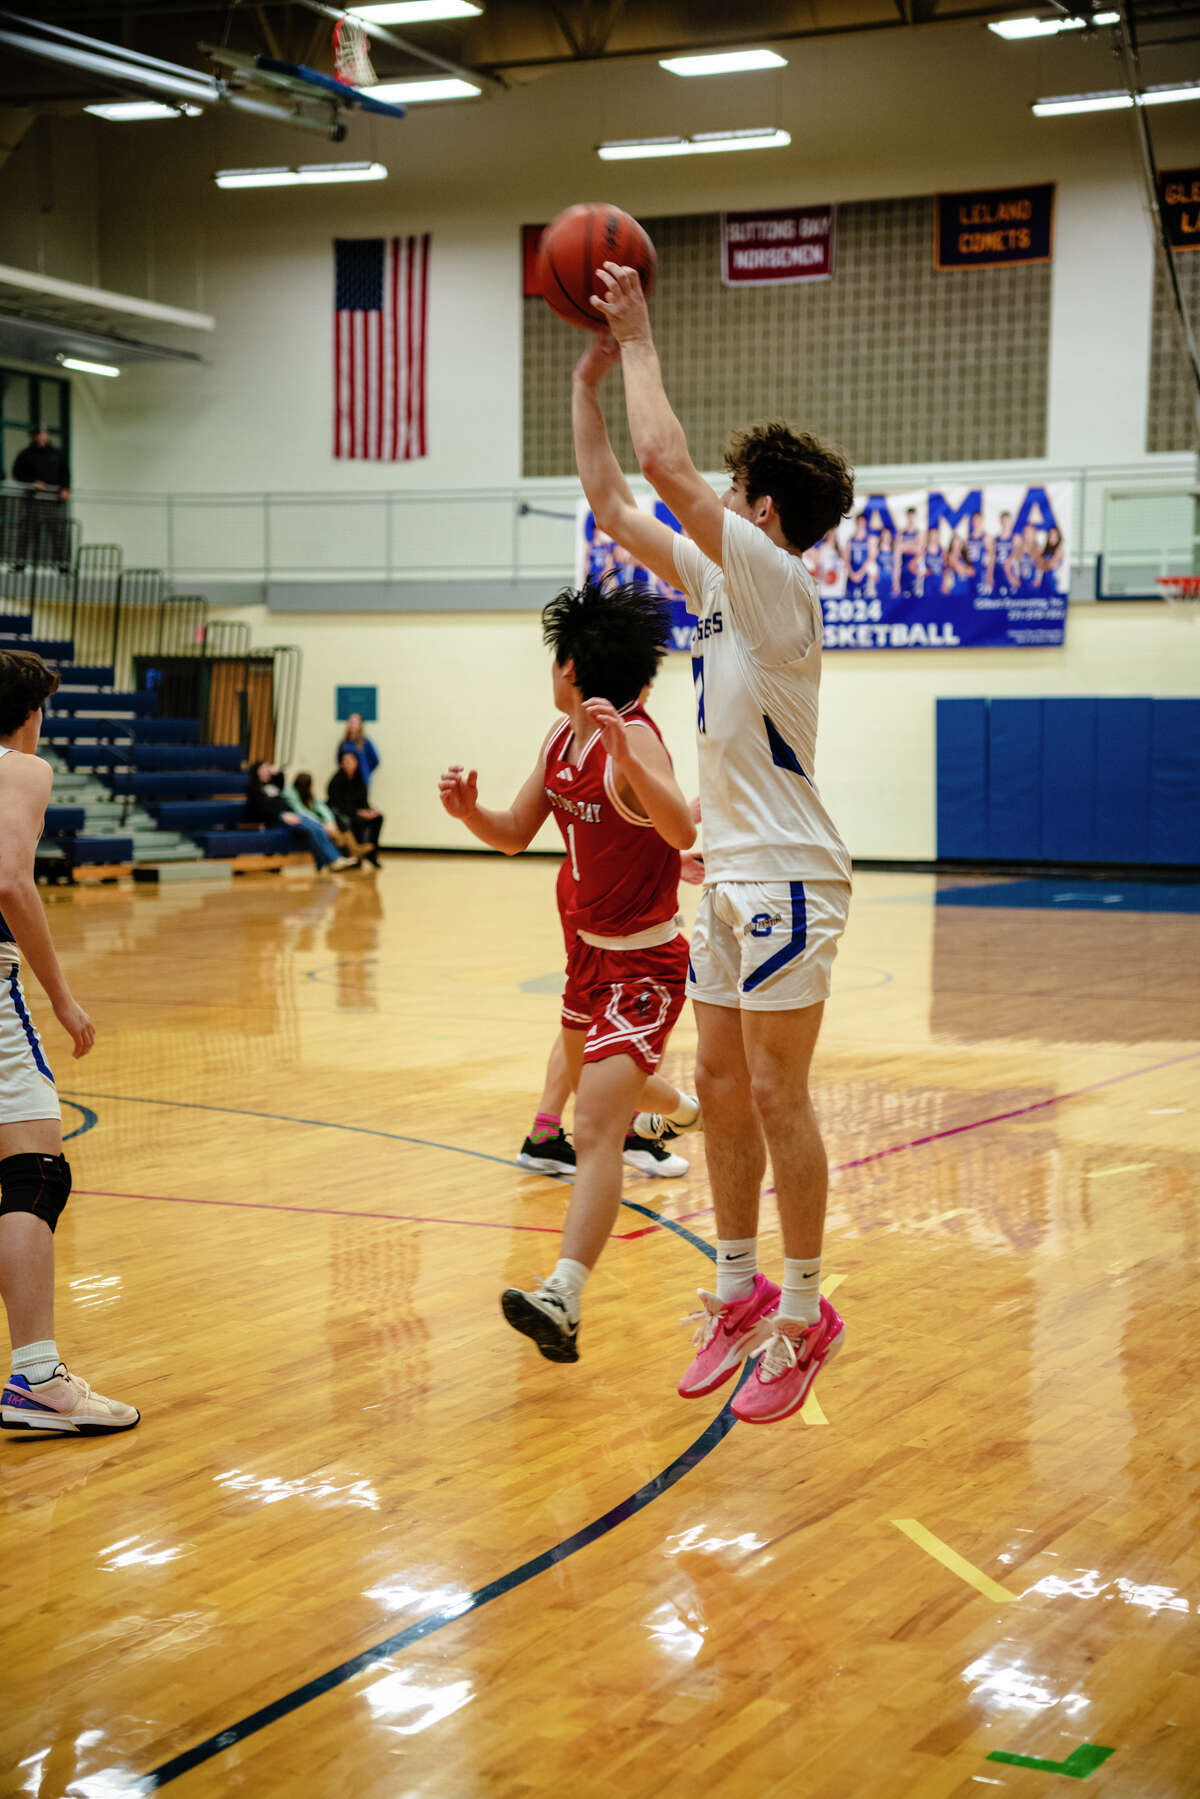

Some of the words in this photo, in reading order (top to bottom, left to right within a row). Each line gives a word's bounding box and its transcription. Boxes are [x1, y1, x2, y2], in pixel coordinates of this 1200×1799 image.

[960, 200, 1031, 224] LELAND
[959, 229, 1031, 253] COMETS
[733, 244, 825, 269] NORSEMEN
[823, 599, 882, 622] 2024
[822, 622, 961, 647] SKETBALL
[566, 823, 580, 882] 1
